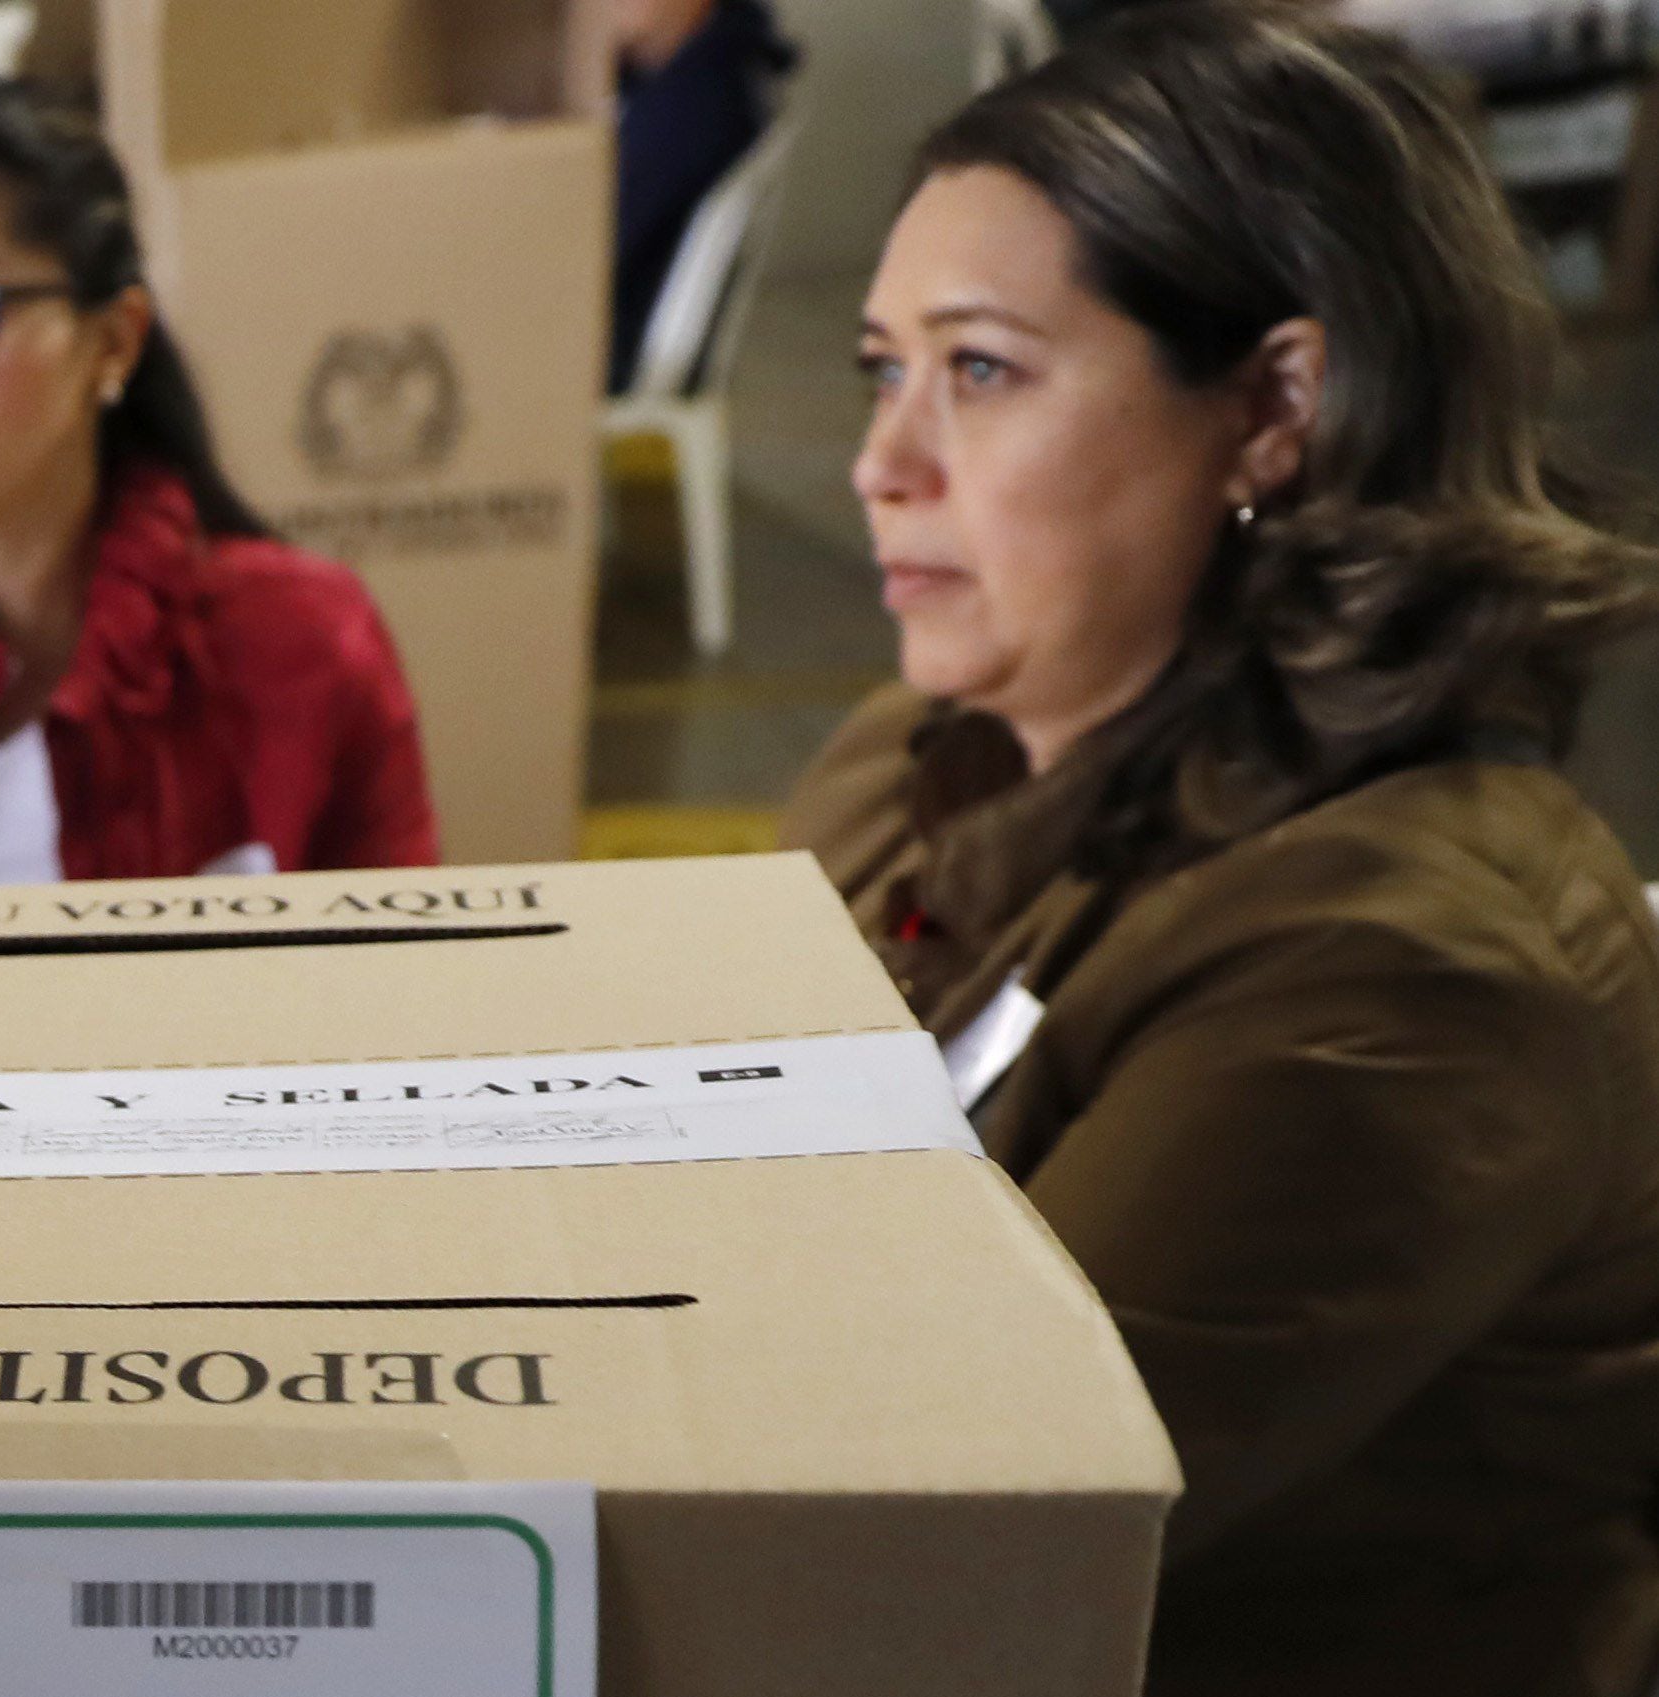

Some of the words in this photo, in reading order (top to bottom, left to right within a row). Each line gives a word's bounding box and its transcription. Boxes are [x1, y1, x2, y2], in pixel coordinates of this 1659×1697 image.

[55, 893, 289, 922] VOTO
[324, 881, 542, 919] AQUÍ
[95, 1094, 148, 1110] Y
[224, 1074, 654, 1107] SELLADA
[153, 1634, 300, 1659] M2000037
